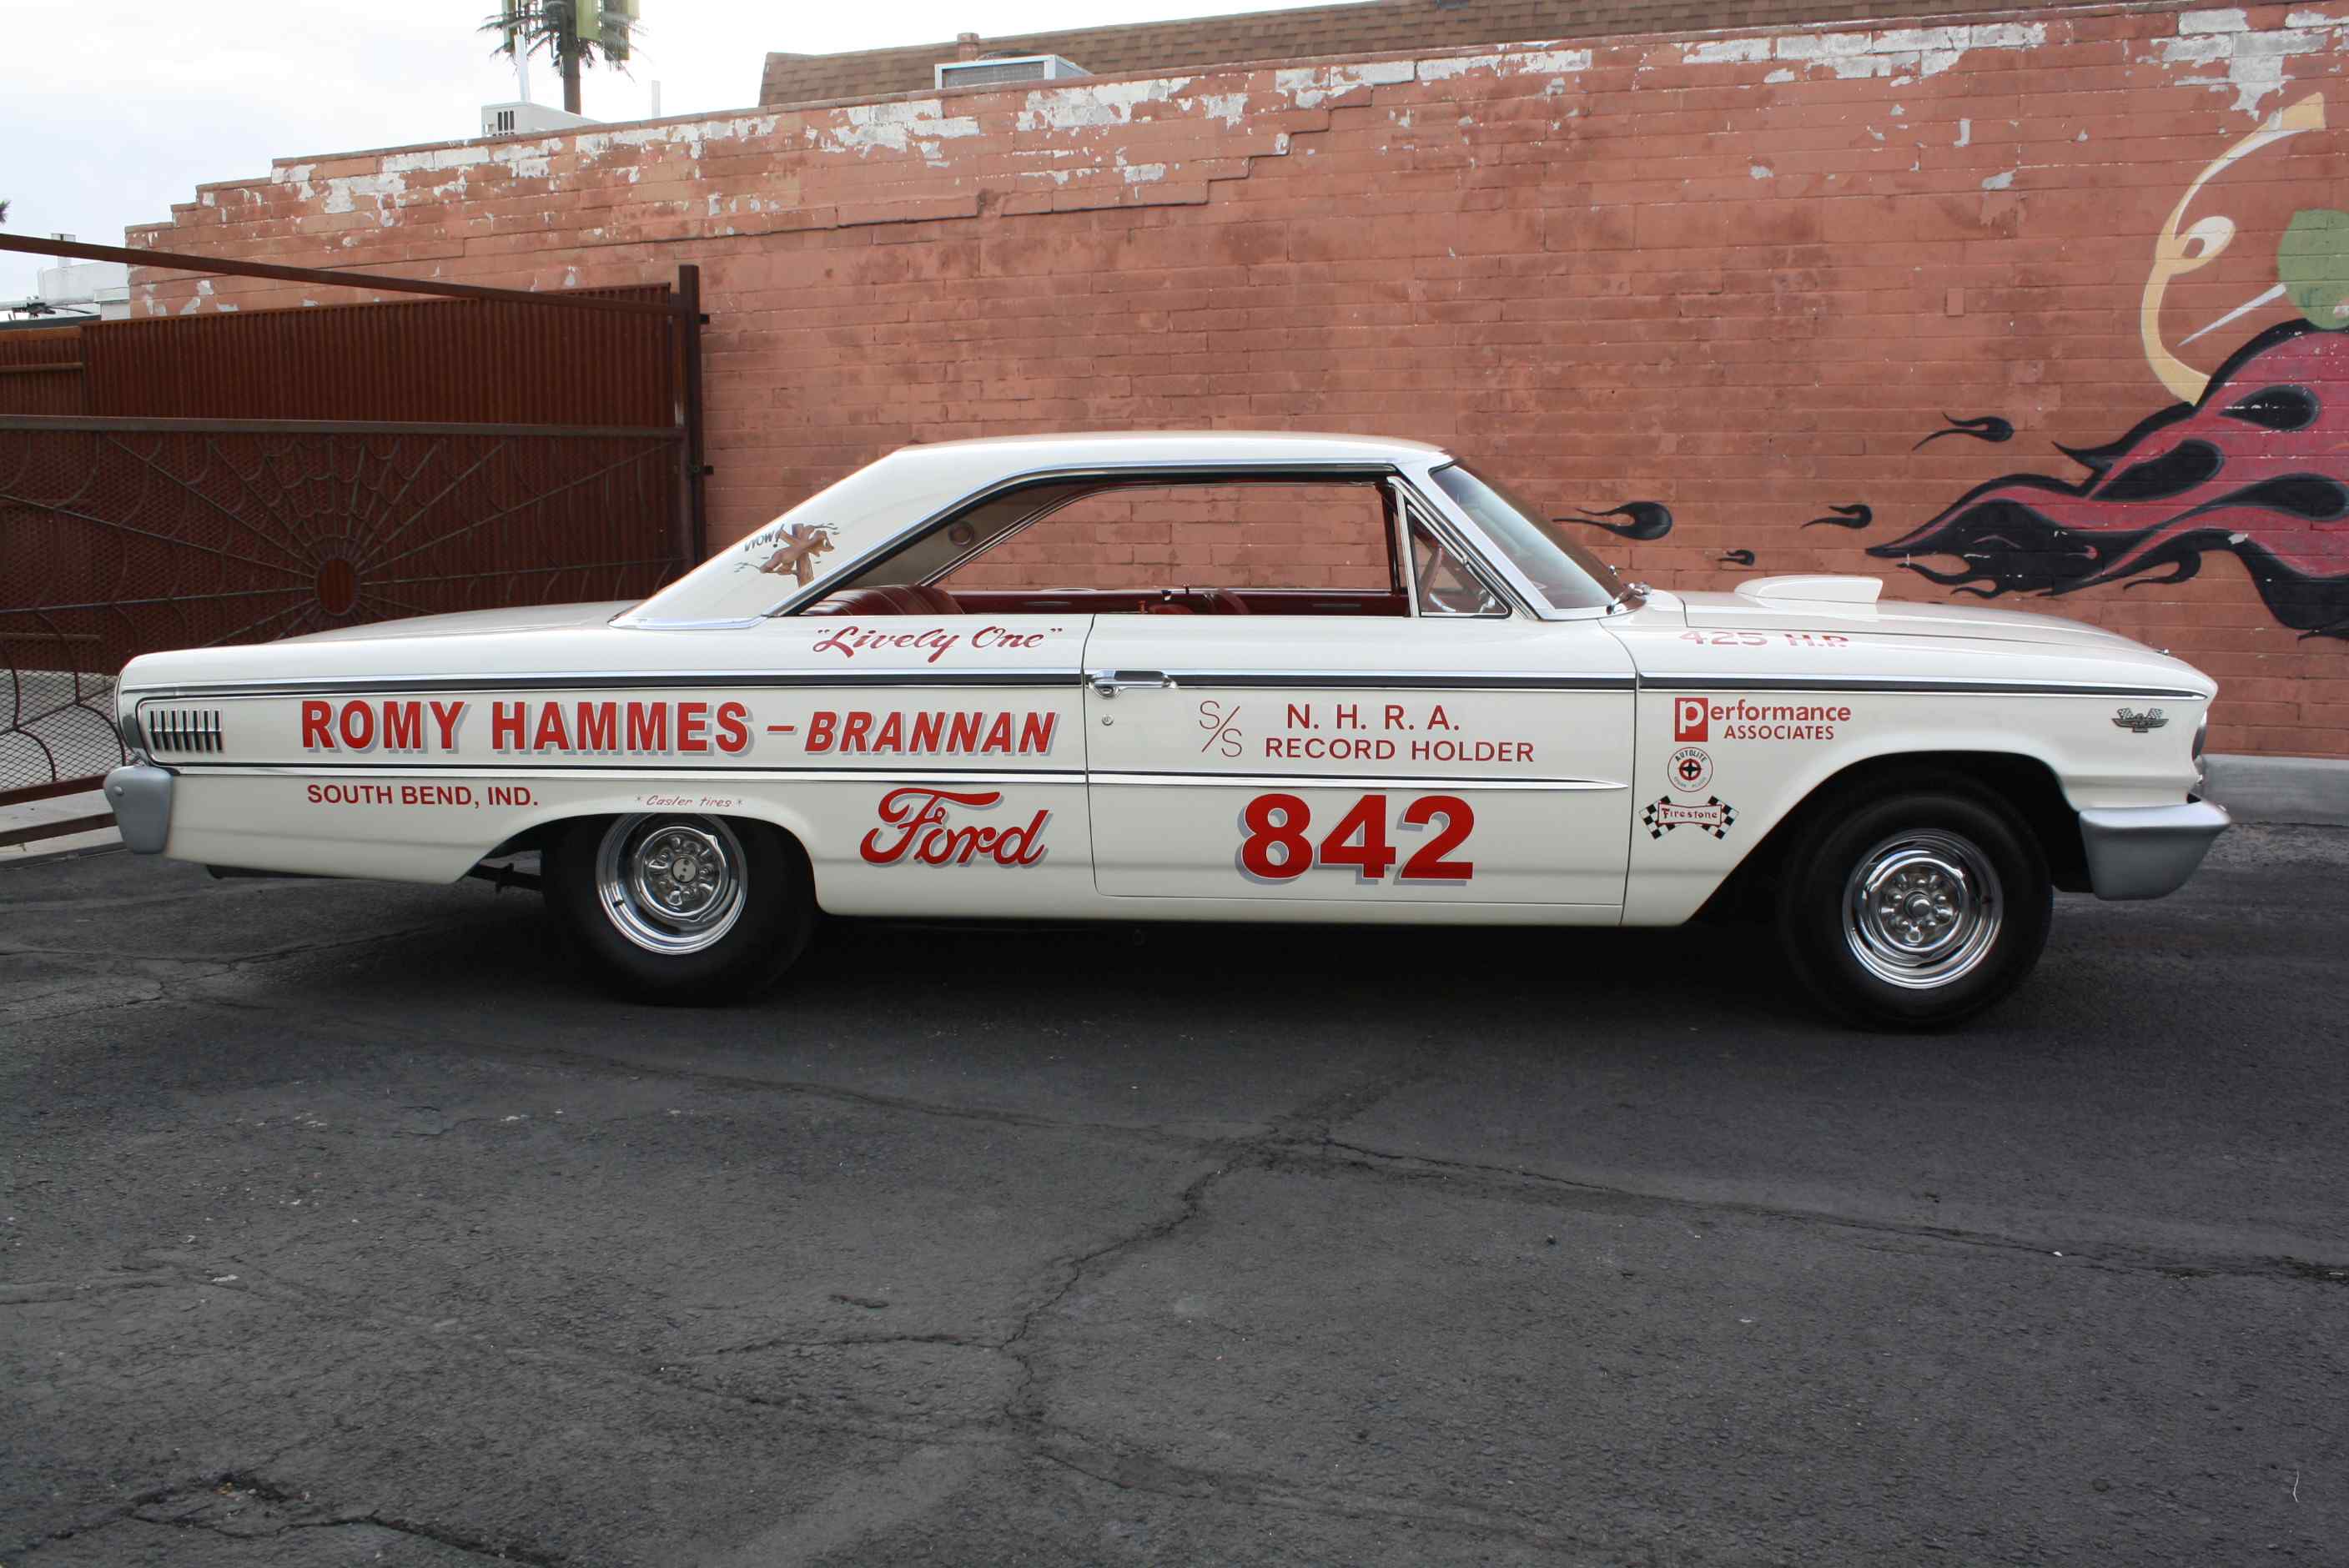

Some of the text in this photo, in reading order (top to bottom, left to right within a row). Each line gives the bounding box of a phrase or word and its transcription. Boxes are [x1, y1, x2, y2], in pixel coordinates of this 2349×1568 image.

[1679, 631, 1768, 646] 425
[302, 700, 470, 752] ROMY
[491, 701, 752, 756] HAMMES
[804, 711, 1059, 756] BRANNAN
[1724, 725, 1834, 740] ASSOCIATES
[1265, 737, 1534, 762] RECORD HOLDER
[1675, 749, 1708, 762] AUTOLITE
[307, 784, 538, 808] SOUTH BEND, IND.
[700, 797, 732, 807] tires
[1662, 808, 1718, 819] Firestone
[860, 787, 1054, 867] Ford
[1235, 793, 1475, 886] 842
